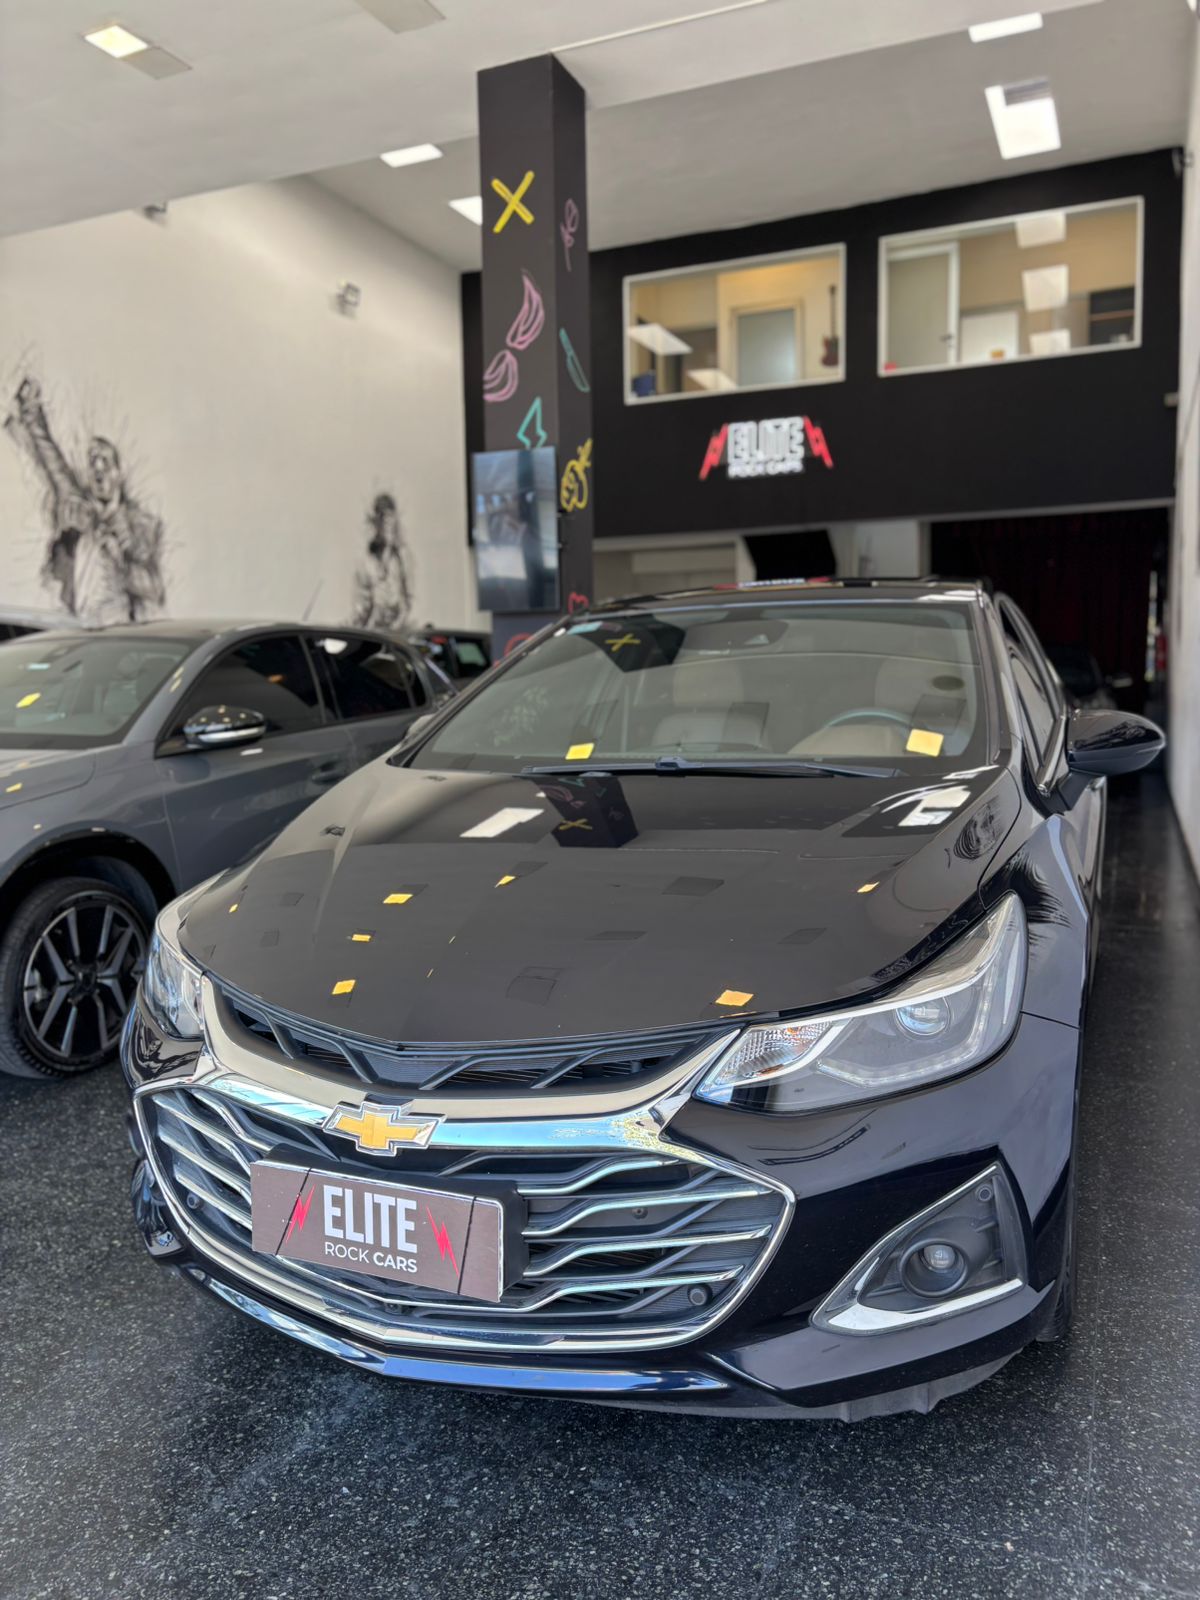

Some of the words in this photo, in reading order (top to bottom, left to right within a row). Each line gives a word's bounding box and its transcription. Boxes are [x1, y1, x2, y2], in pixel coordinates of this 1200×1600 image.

[728, 416, 804, 464] ELITE
[323, 1184, 417, 1253] ELITE
[324, 1242, 369, 1264] ROCK
[373, 1252, 417, 1273] CARS
